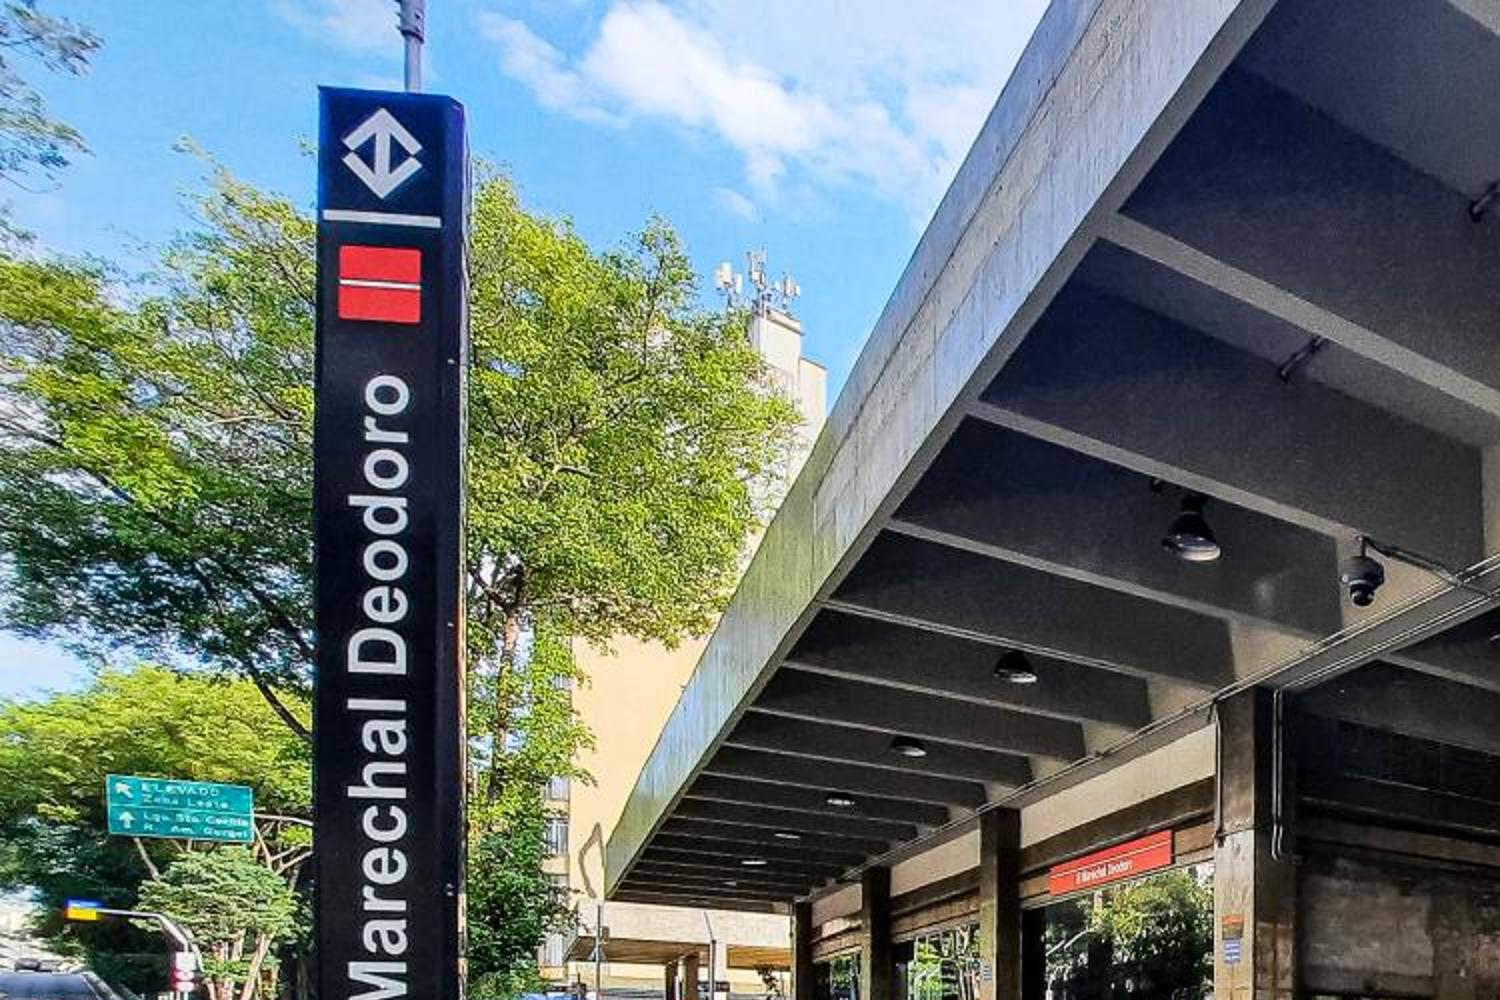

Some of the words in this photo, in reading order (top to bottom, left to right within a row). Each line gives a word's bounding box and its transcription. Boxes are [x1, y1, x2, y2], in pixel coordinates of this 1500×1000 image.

[347, 374, 410, 675] Deodoro
[141, 783, 220, 797] ELEVADO
[143, 794, 179, 805] Zona
[187, 798, 229, 809] Leste
